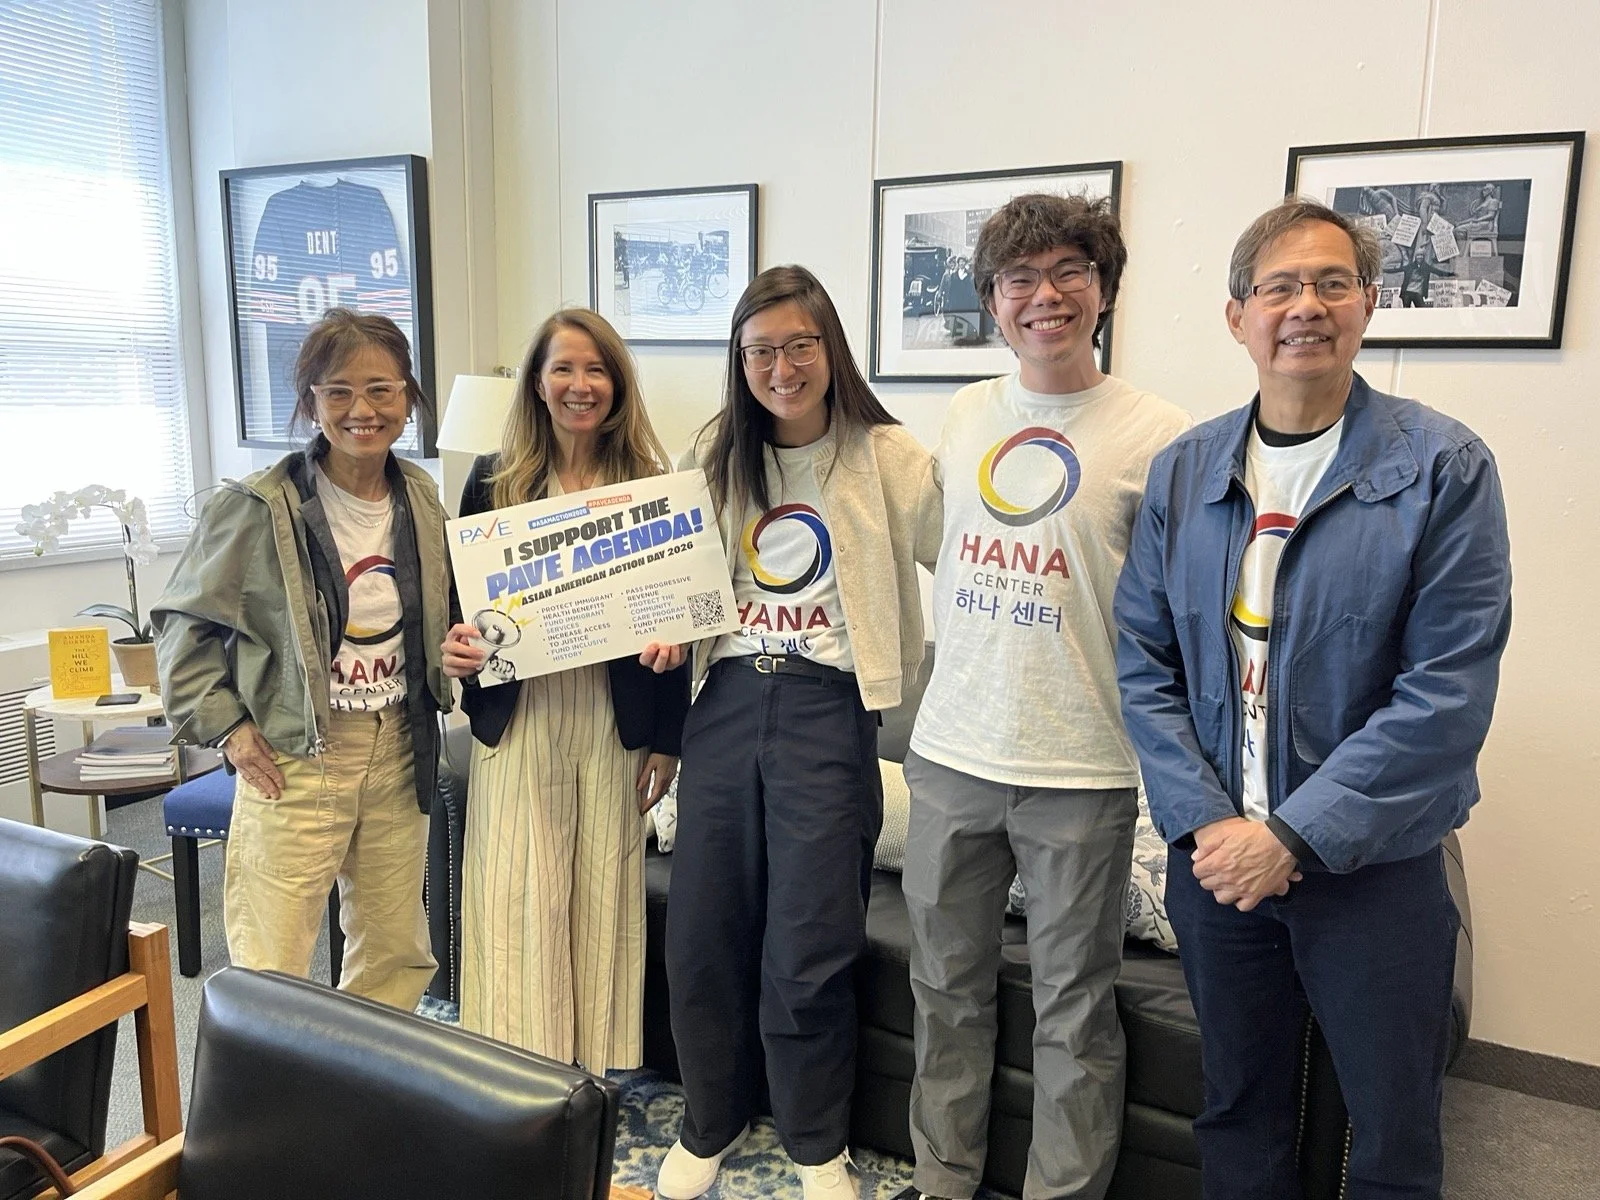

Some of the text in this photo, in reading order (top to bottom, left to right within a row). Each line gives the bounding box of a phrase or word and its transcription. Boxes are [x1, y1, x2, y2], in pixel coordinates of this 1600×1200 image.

[307, 231, 336, 254] DENT
[255, 254, 278, 281] 95
[371, 248, 398, 279] 95
[460, 517, 512, 544] PAVE
[503, 547, 514, 567] I
[518, 511, 624, 561] SUPPORT
[628, 497, 671, 525] THE
[486, 507, 704, 601] PAVE AGENDA!
[960, 533, 1070, 579] HANA
[522, 541, 694, 606] ASIAN AMERICAN ACTION DAY 2026
[626, 576, 691, 595] PASS PROGRESSIVE
[974, 572, 1044, 596] CENTER
[541, 593, 613, 613] PROTECT IMMIGRANT
[627, 590, 659, 601] REVENUE
[629, 597, 661, 608] PROTECT
[543, 602, 605, 620] HEALTH BENEFITS
[631, 601, 671, 615] COMMUNITY
[632, 605, 686, 622] CARE PROGRAM
[956, 588, 1062, 632] 하나 센터
[544, 609, 604, 627] FUND IMMIGRANT
[634, 612, 685, 629] FUND FAITH BY
[546, 622, 580, 634] SERVICES
[548, 622, 611, 641] INCREASE ACCESS
[635, 627, 657, 635] PLATE
[551, 637, 608, 655] FUND INCLUSIVE
[561, 634, 589, 645] JUSTICE
[553, 651, 582, 662] HISTORY
